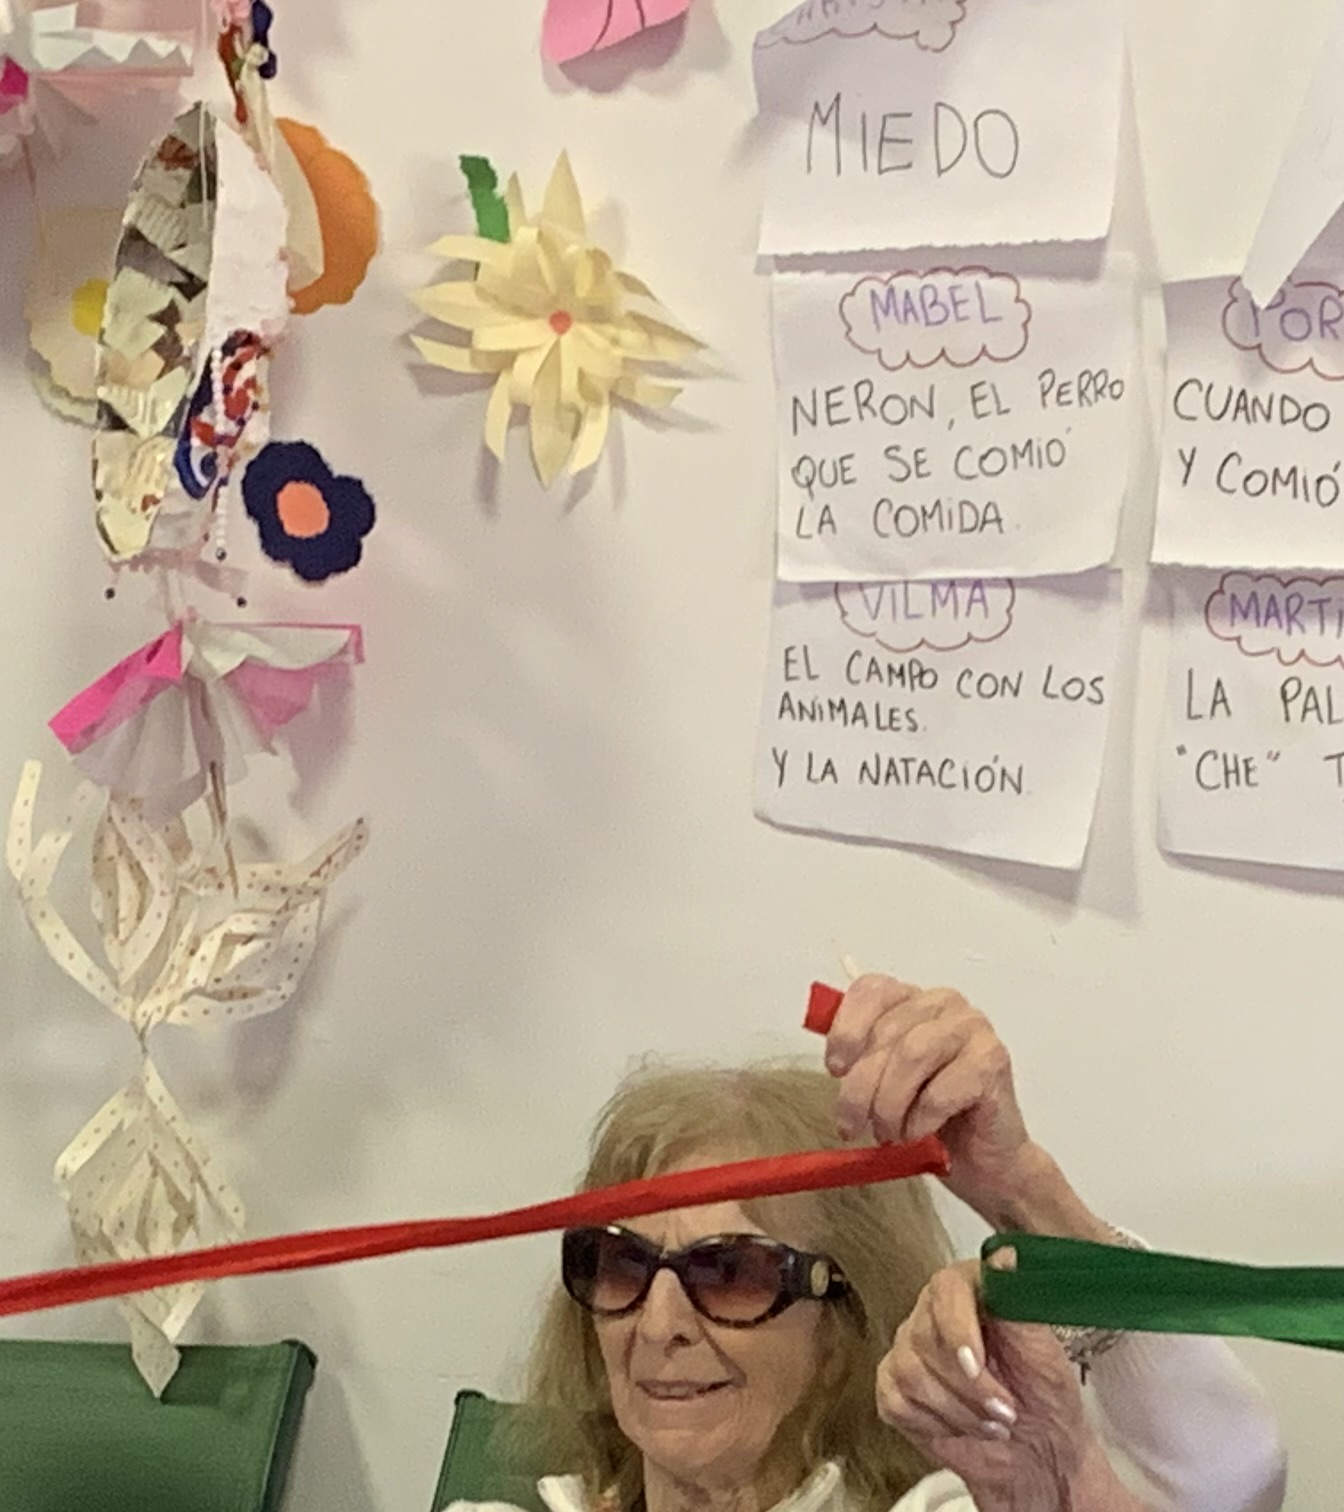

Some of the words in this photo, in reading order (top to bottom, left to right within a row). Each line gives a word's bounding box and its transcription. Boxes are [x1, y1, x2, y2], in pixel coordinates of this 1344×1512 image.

[806, 91, 1020, 180] MIEDO
[870, 281, 1002, 331] MABEL
[791, 377, 955, 437] NERON,
[969, 379, 1012, 421] EL
[1037, 367, 1125, 410] PERRO
[1172, 377, 1331, 434] CUANDO
[790, 452, 858, 502] QUE
[883, 444, 932, 484] SE
[1177, 445, 1197, 488] Y
[1215, 450, 1342, 509] COMIÓ
[795, 503, 838, 540] LA
[857, 578, 989, 622] VILMA
[783, 644, 820, 683] EL
[845, 649, 939, 693] CAMPO
[955, 667, 1024, 700] CON
[1041, 663, 1105, 706] LOS
[1186, 667, 1232, 721] LA
[771, 746, 789, 789] Y
[806, 750, 839, 785] LA
